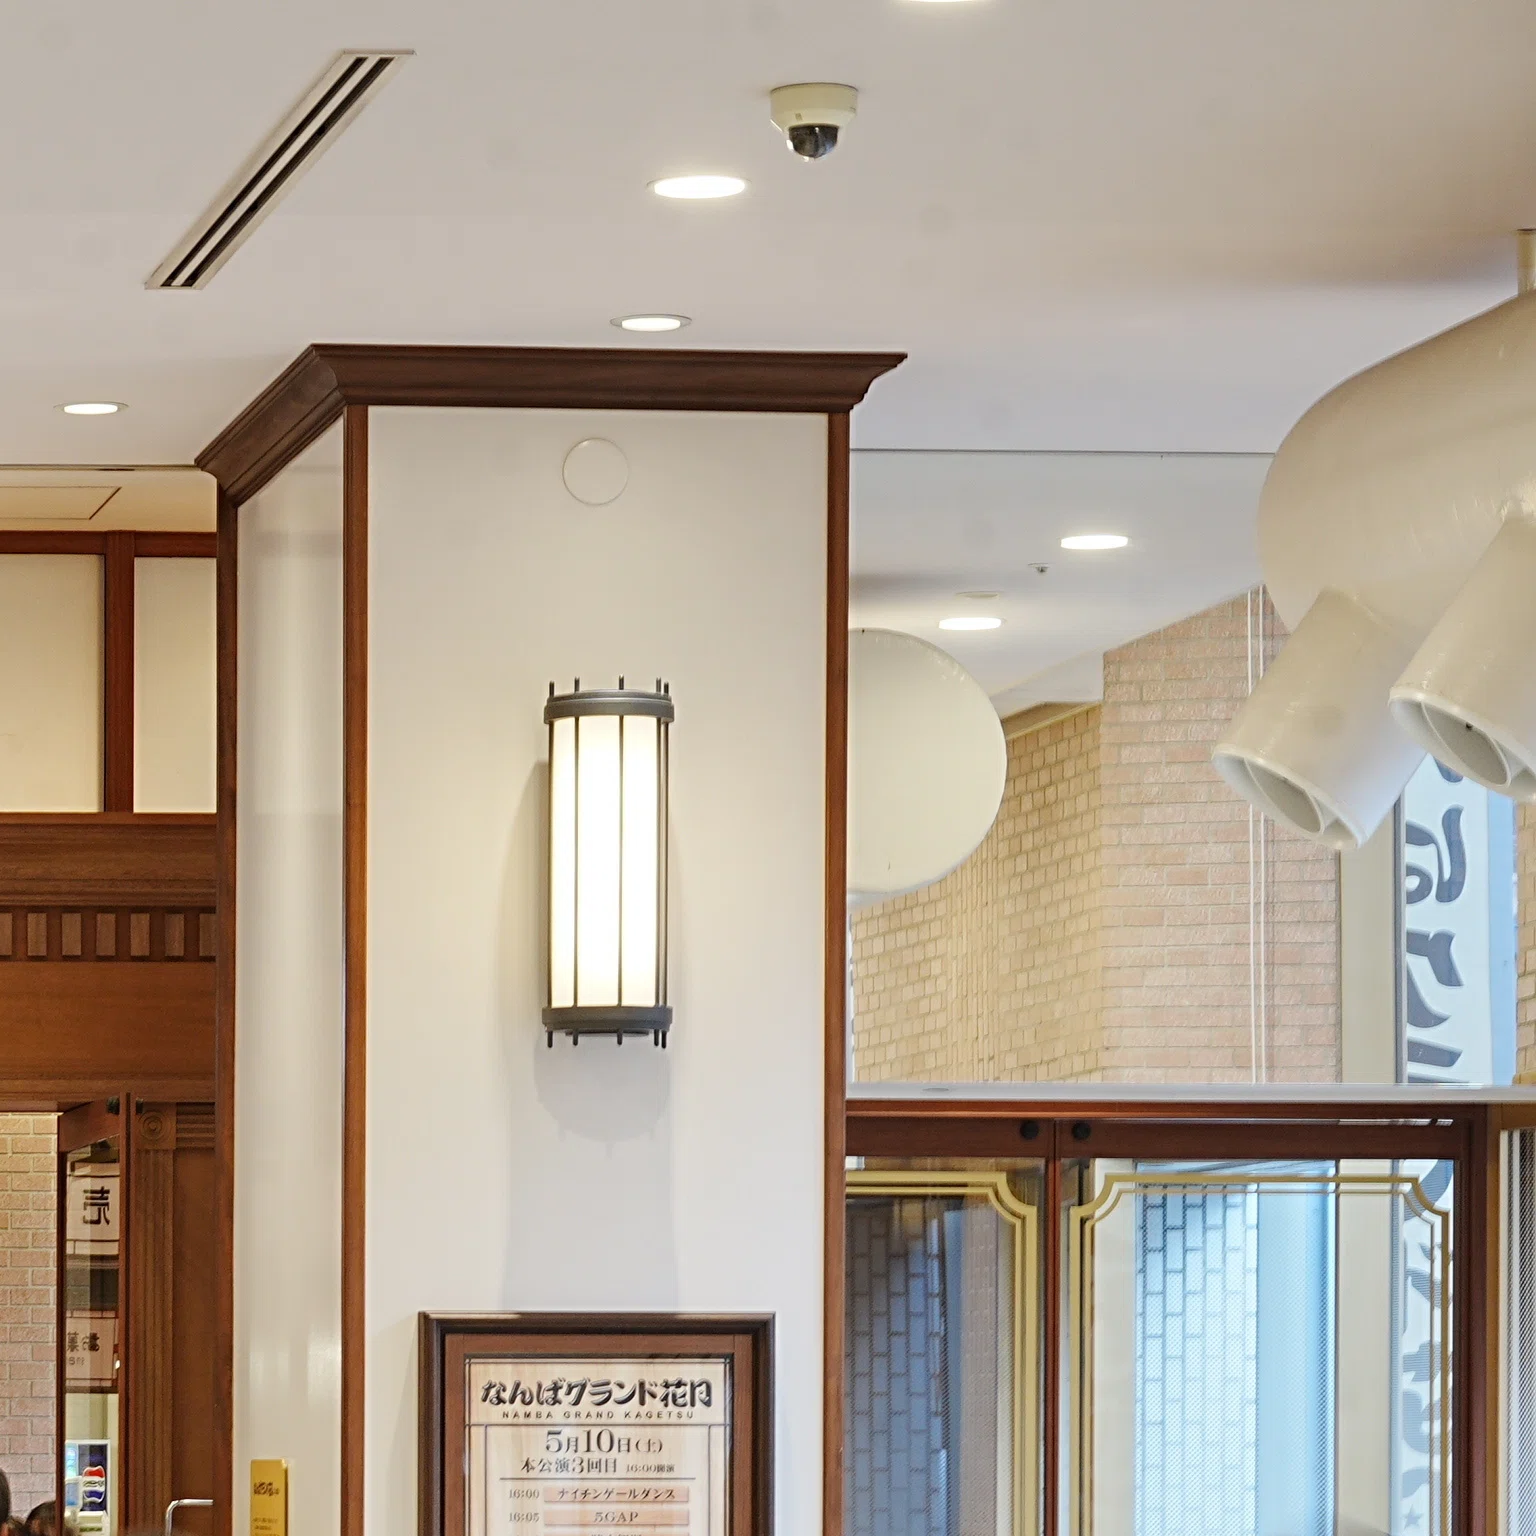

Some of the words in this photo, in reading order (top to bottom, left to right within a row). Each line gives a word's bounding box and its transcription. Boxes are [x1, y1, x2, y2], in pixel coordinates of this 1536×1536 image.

[481, 1377, 712, 1408] なんばグランド花月
[502, 1410, 554, 1420] NAMBA
[563, 1410, 615, 1420] GRAND
[624, 1410, 695, 1420] KAGETSU
[520, 1456, 618, 1475] 本公演3回目
[508, 1489, 540, 1500] 16:00
[557, 1487, 676, 1501] ナイチンゲールダンス
[508, 1512, 540, 1523] 16:05
[592, 1511, 640, 1523] 5GAP
